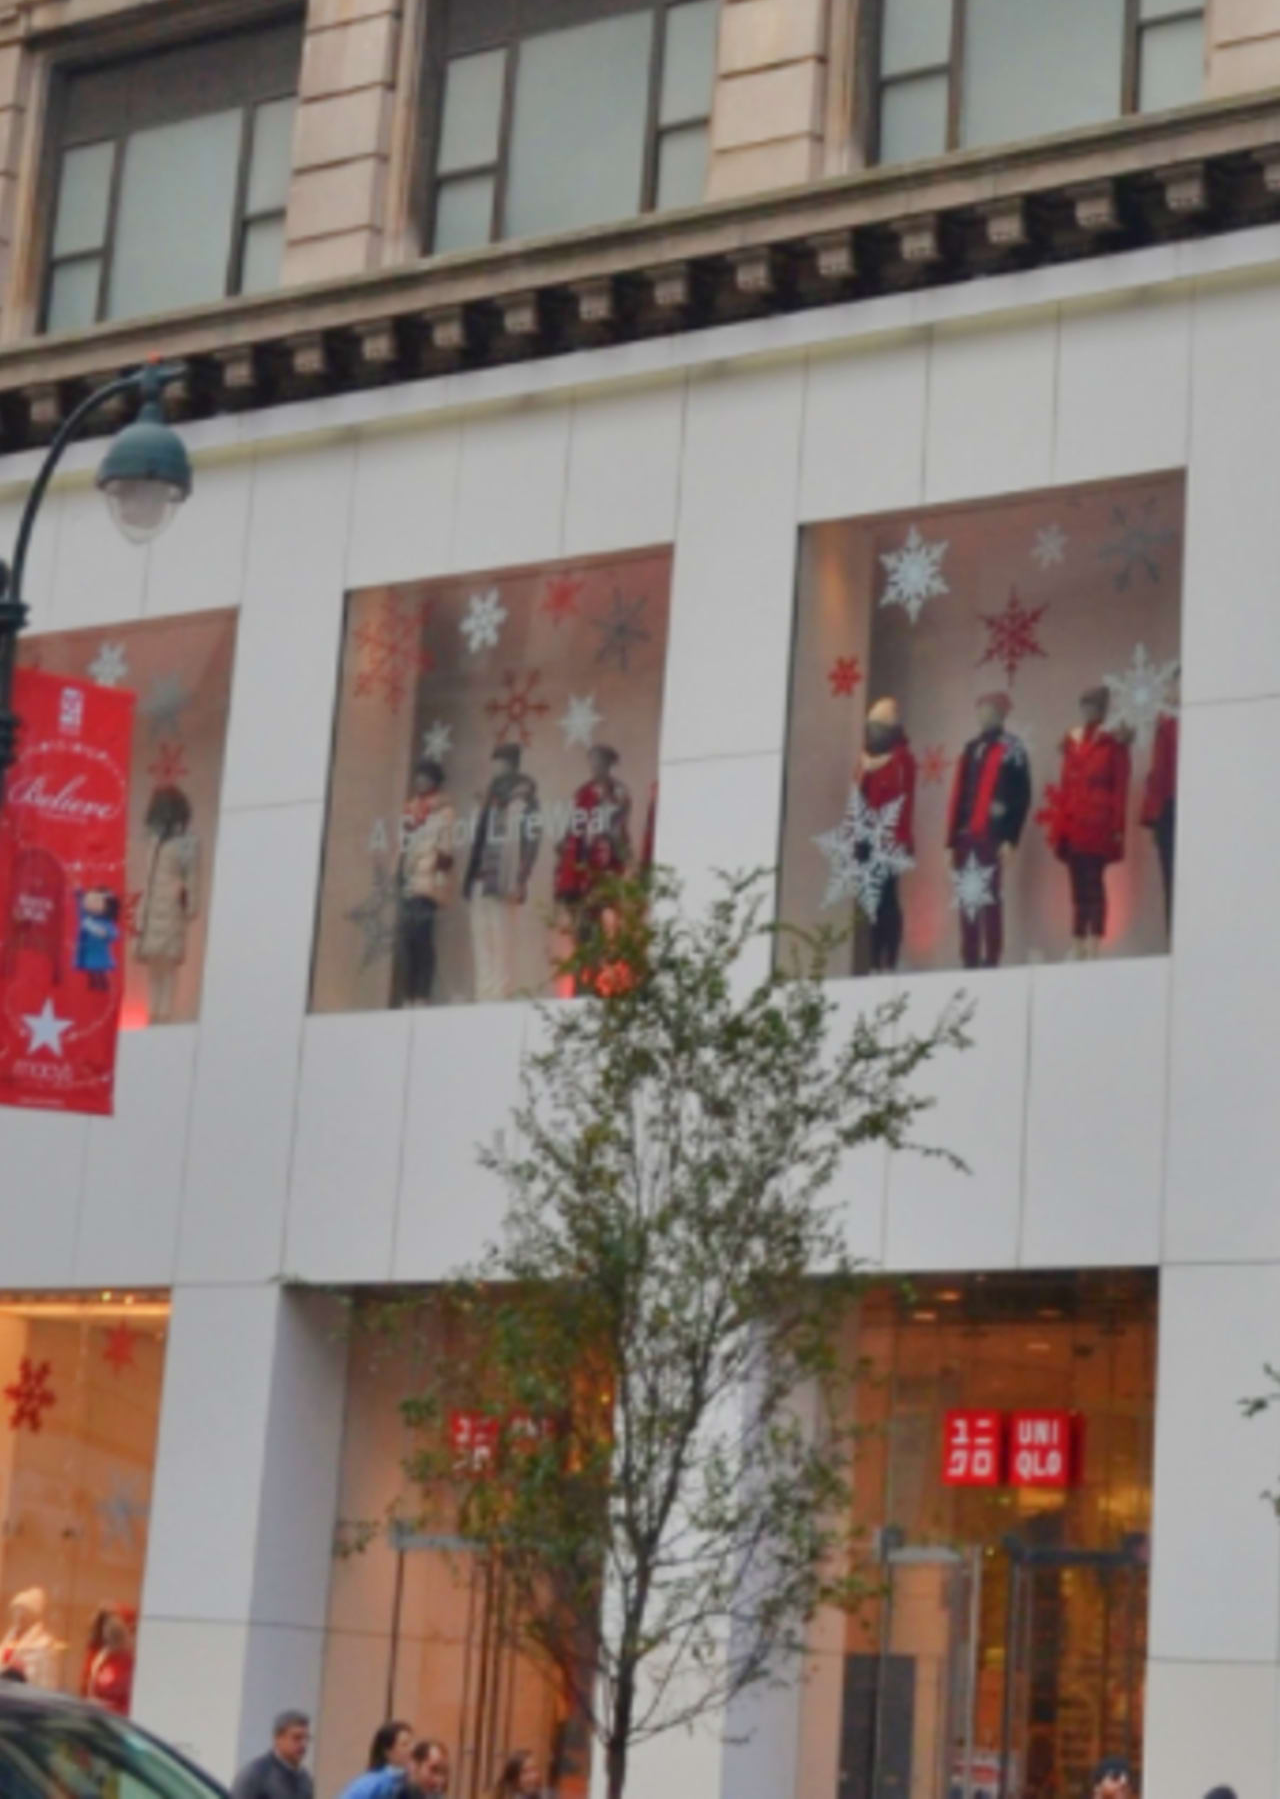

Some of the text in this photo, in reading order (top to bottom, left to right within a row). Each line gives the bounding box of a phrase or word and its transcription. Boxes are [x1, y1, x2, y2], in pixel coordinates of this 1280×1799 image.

[951, 1418, 993, 1446] ユニ
[1018, 1418, 1060, 1445] UNI
[947, 1449, 993, 1477] クロ
[1015, 1449, 1062, 1481] QLO
